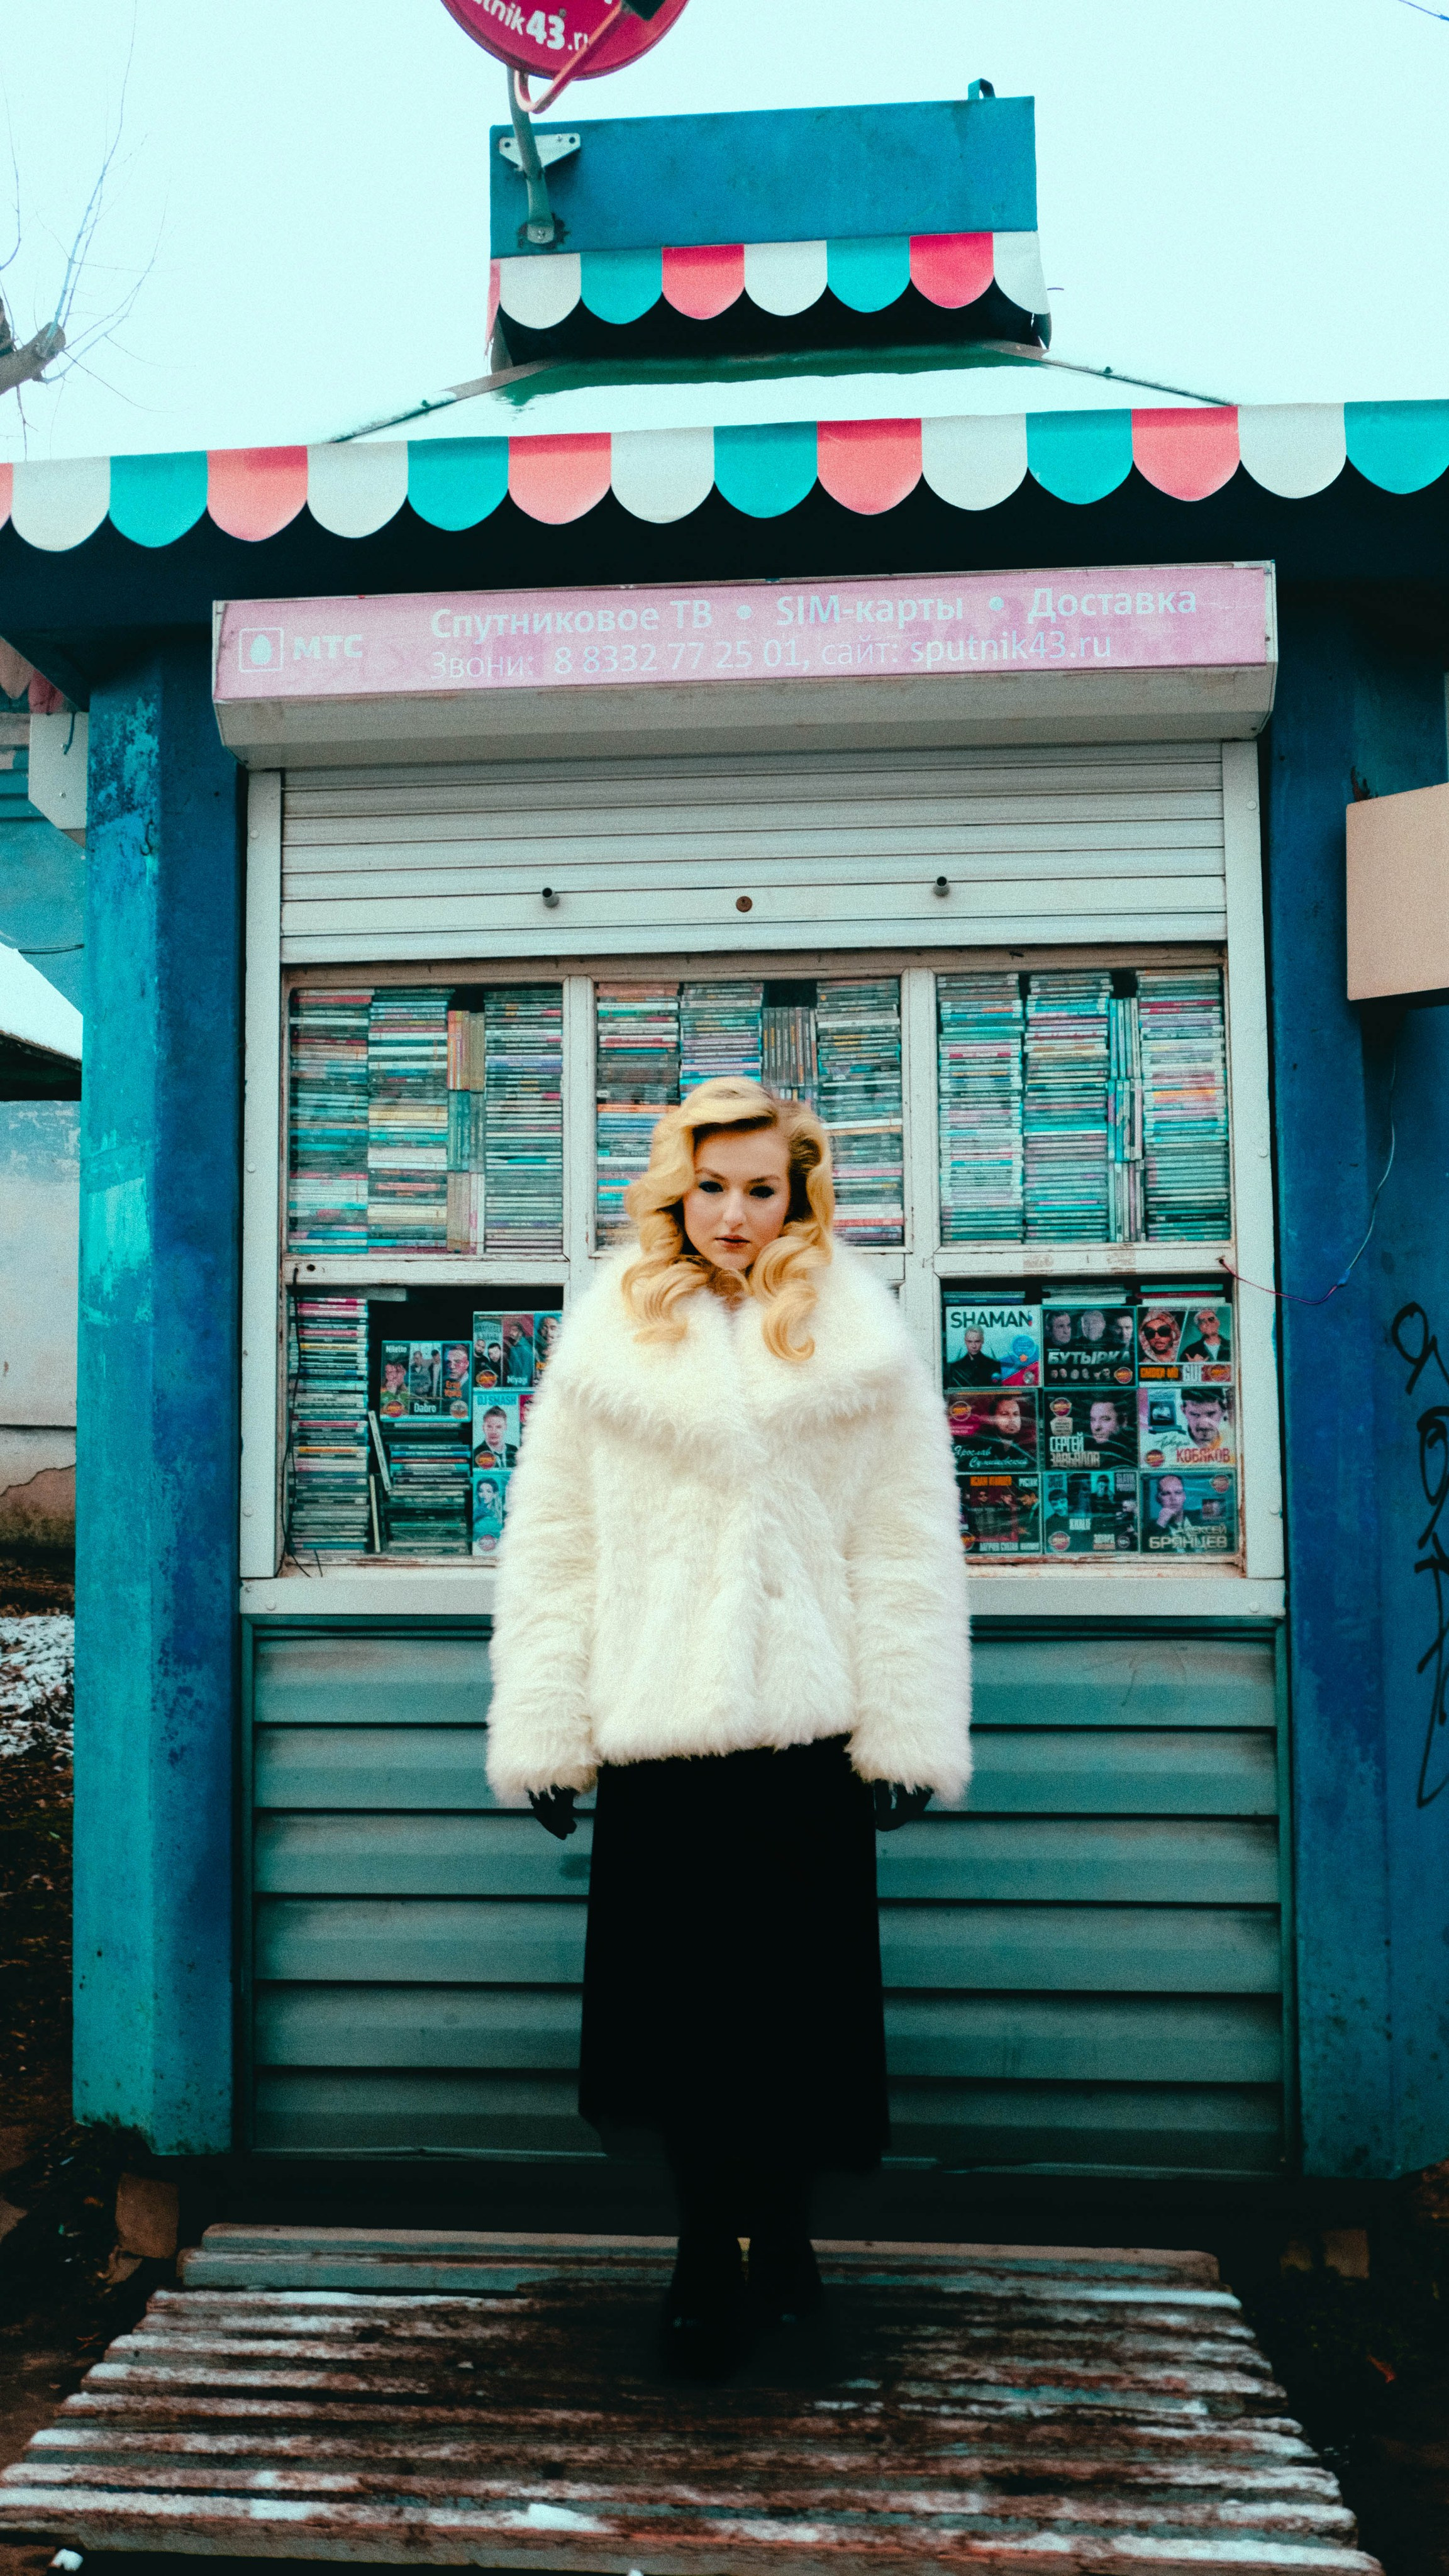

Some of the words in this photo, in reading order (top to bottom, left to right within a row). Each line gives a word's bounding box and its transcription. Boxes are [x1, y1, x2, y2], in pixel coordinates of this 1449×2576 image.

[431, 608, 659, 644] Спутниковое
[670, 599, 712, 629] ТВ
[777, 595, 963, 629] SIM-карты
[1027, 589, 1197, 623] Доставка
[293, 634, 363, 660] МТС
[431, 652, 533, 680] Звони:
[553, 648, 572, 675] 8
[582, 645, 658, 674] 8332
[669, 643, 704, 670] 77
[716, 641, 754, 669] 25
[821, 636, 899, 665] сайт:
[910, 631, 1112, 669] sputnik43.ru
[950, 1311, 1030, 1328] SHAMAN
[1048, 1350, 1131, 1365] БУТЫРКА
[1050, 1431, 1084, 1452] СЕРГЕЙ
[1176, 1448, 1230, 1463] КОБЯКОВ
[1148, 1536, 1228, 1550] БРЯНЦЕВ
